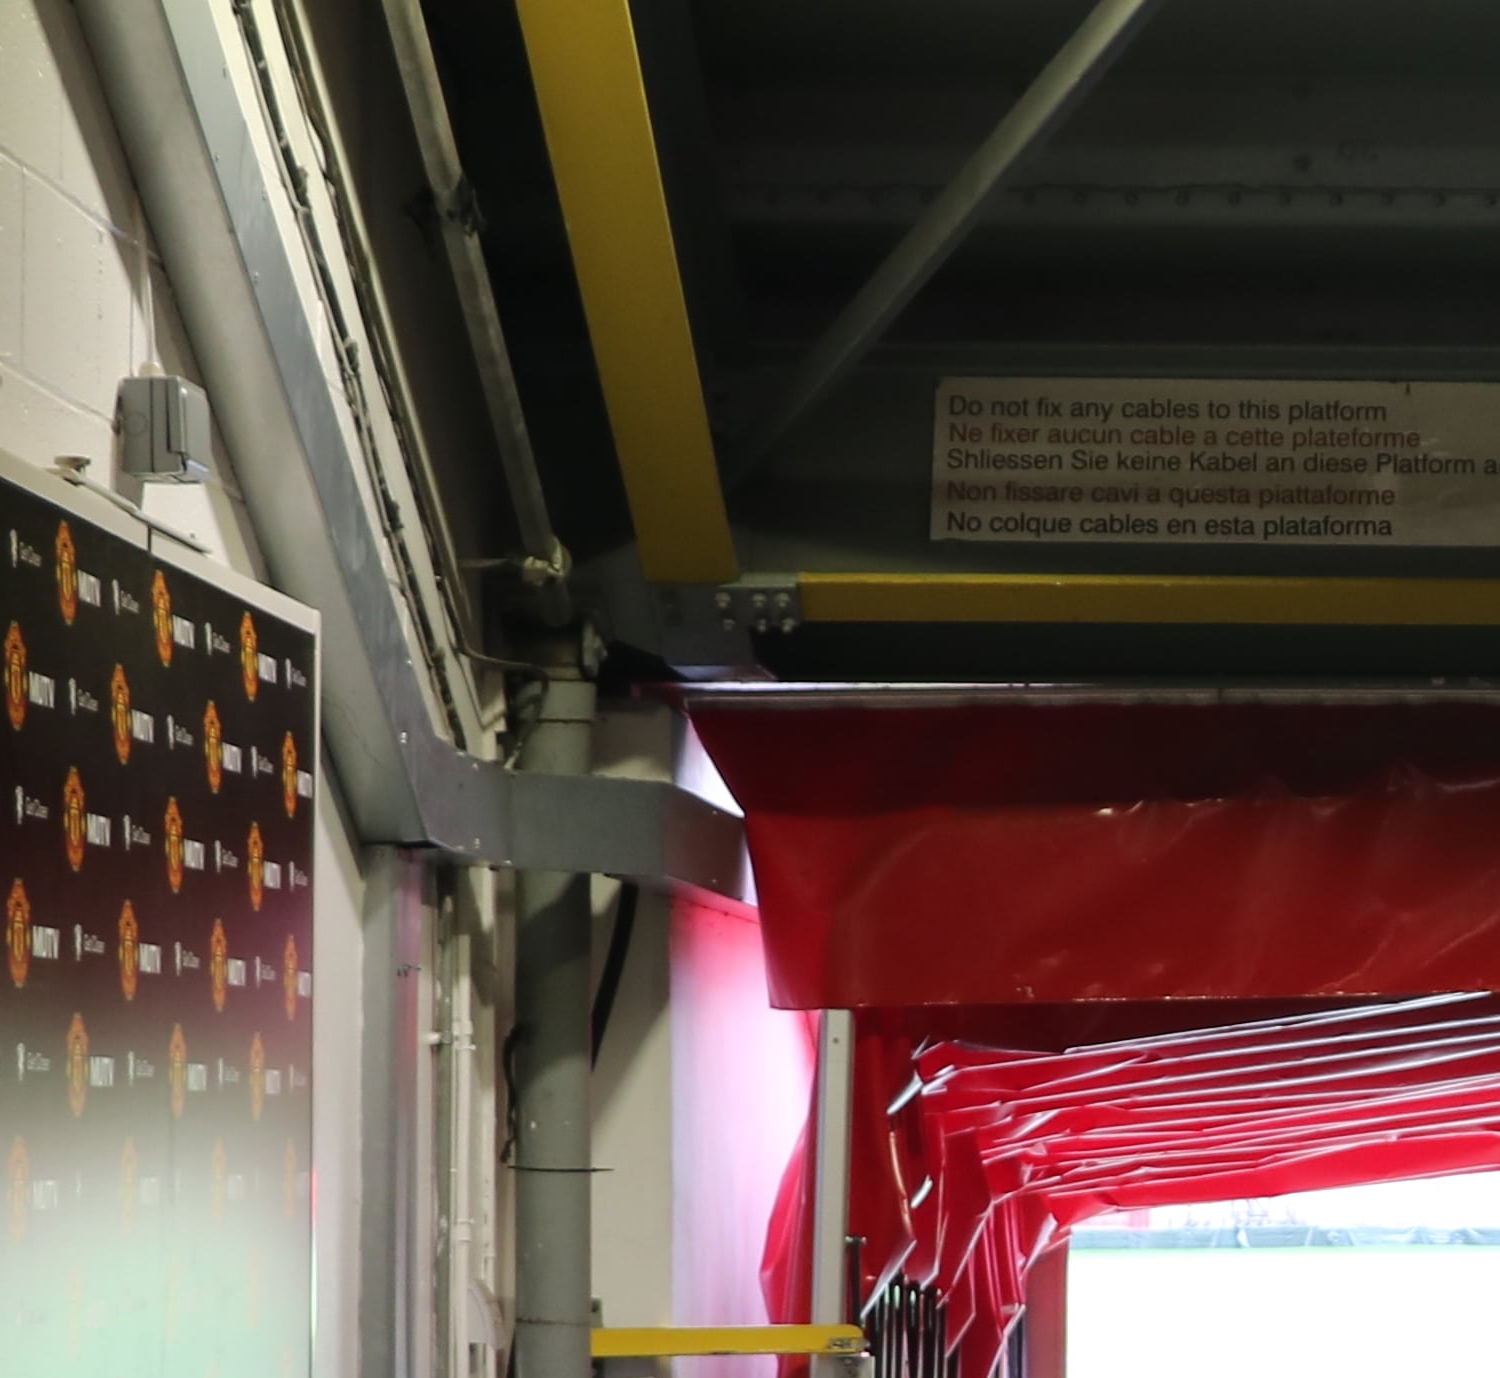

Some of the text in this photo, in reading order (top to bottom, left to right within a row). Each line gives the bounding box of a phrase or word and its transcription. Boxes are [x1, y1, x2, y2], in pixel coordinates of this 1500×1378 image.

[949, 396, 1386, 425] Do not fix any cables to this platform
[948, 423, 1420, 451] Ne fixer aucun cable a cette plateforme
[948, 449, 1063, 470] Shliessen
[1071, 451, 1108, 470] Sie
[1116, 451, 1180, 471] keine
[1190, 452, 1258, 472] Kabel
[1266, 457, 1295, 472] an
[1304, 453, 1367, 473] diese
[1376, 453, 1475, 474] Platform
[946, 481, 1395, 508] Non fissare cavi a questa piattaforme
[948, 513, 1392, 540] No colque cables en esta plataforma
